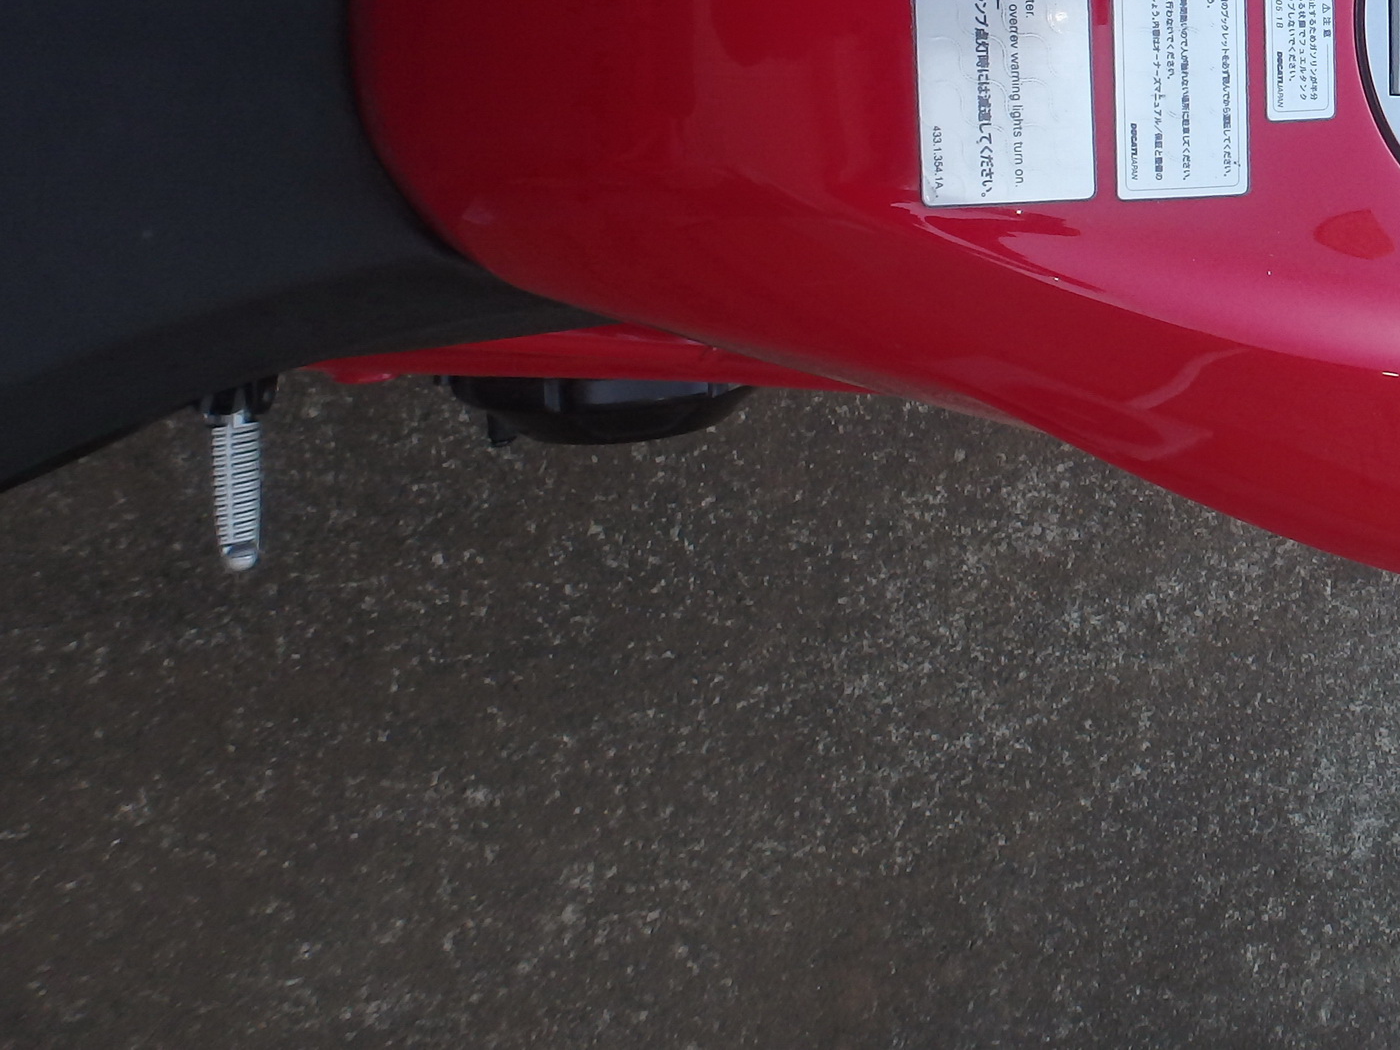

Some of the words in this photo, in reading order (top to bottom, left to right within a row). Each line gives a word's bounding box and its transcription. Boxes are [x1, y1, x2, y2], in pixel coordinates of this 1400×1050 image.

[1009, 4, 1019, 48] overrev
[1009, 52, 1022, 101] warning
[1009, 104, 1024, 138] lights
[932, 125, 943, 190] 433.1.354.1A
[1013, 141, 1024, 166] turn
[1014, 168, 1024, 188] on.
